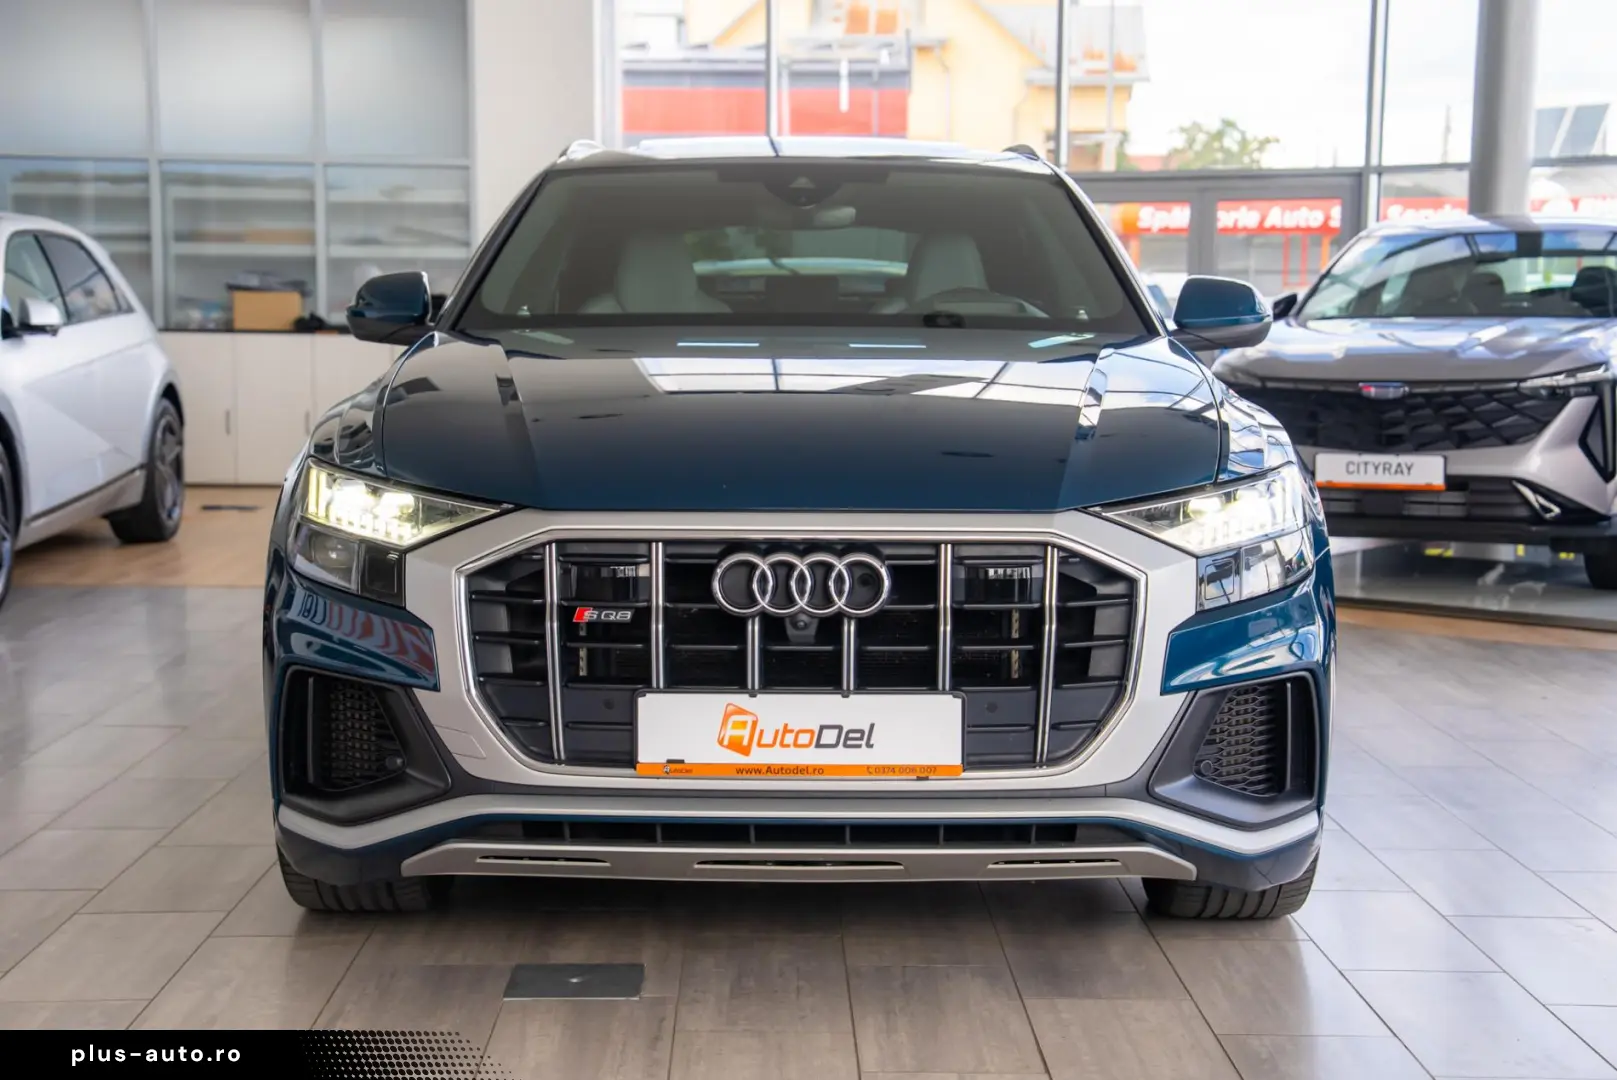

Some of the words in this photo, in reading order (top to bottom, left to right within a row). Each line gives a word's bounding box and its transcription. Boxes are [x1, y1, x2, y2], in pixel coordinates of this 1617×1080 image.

[1264, 206, 1324, 228] Auto
[1345, 460, 1414, 476] CITYRAY
[719, 706, 875, 754] AutoDel
[735, 765, 825, 776] www.Autodel.ro
